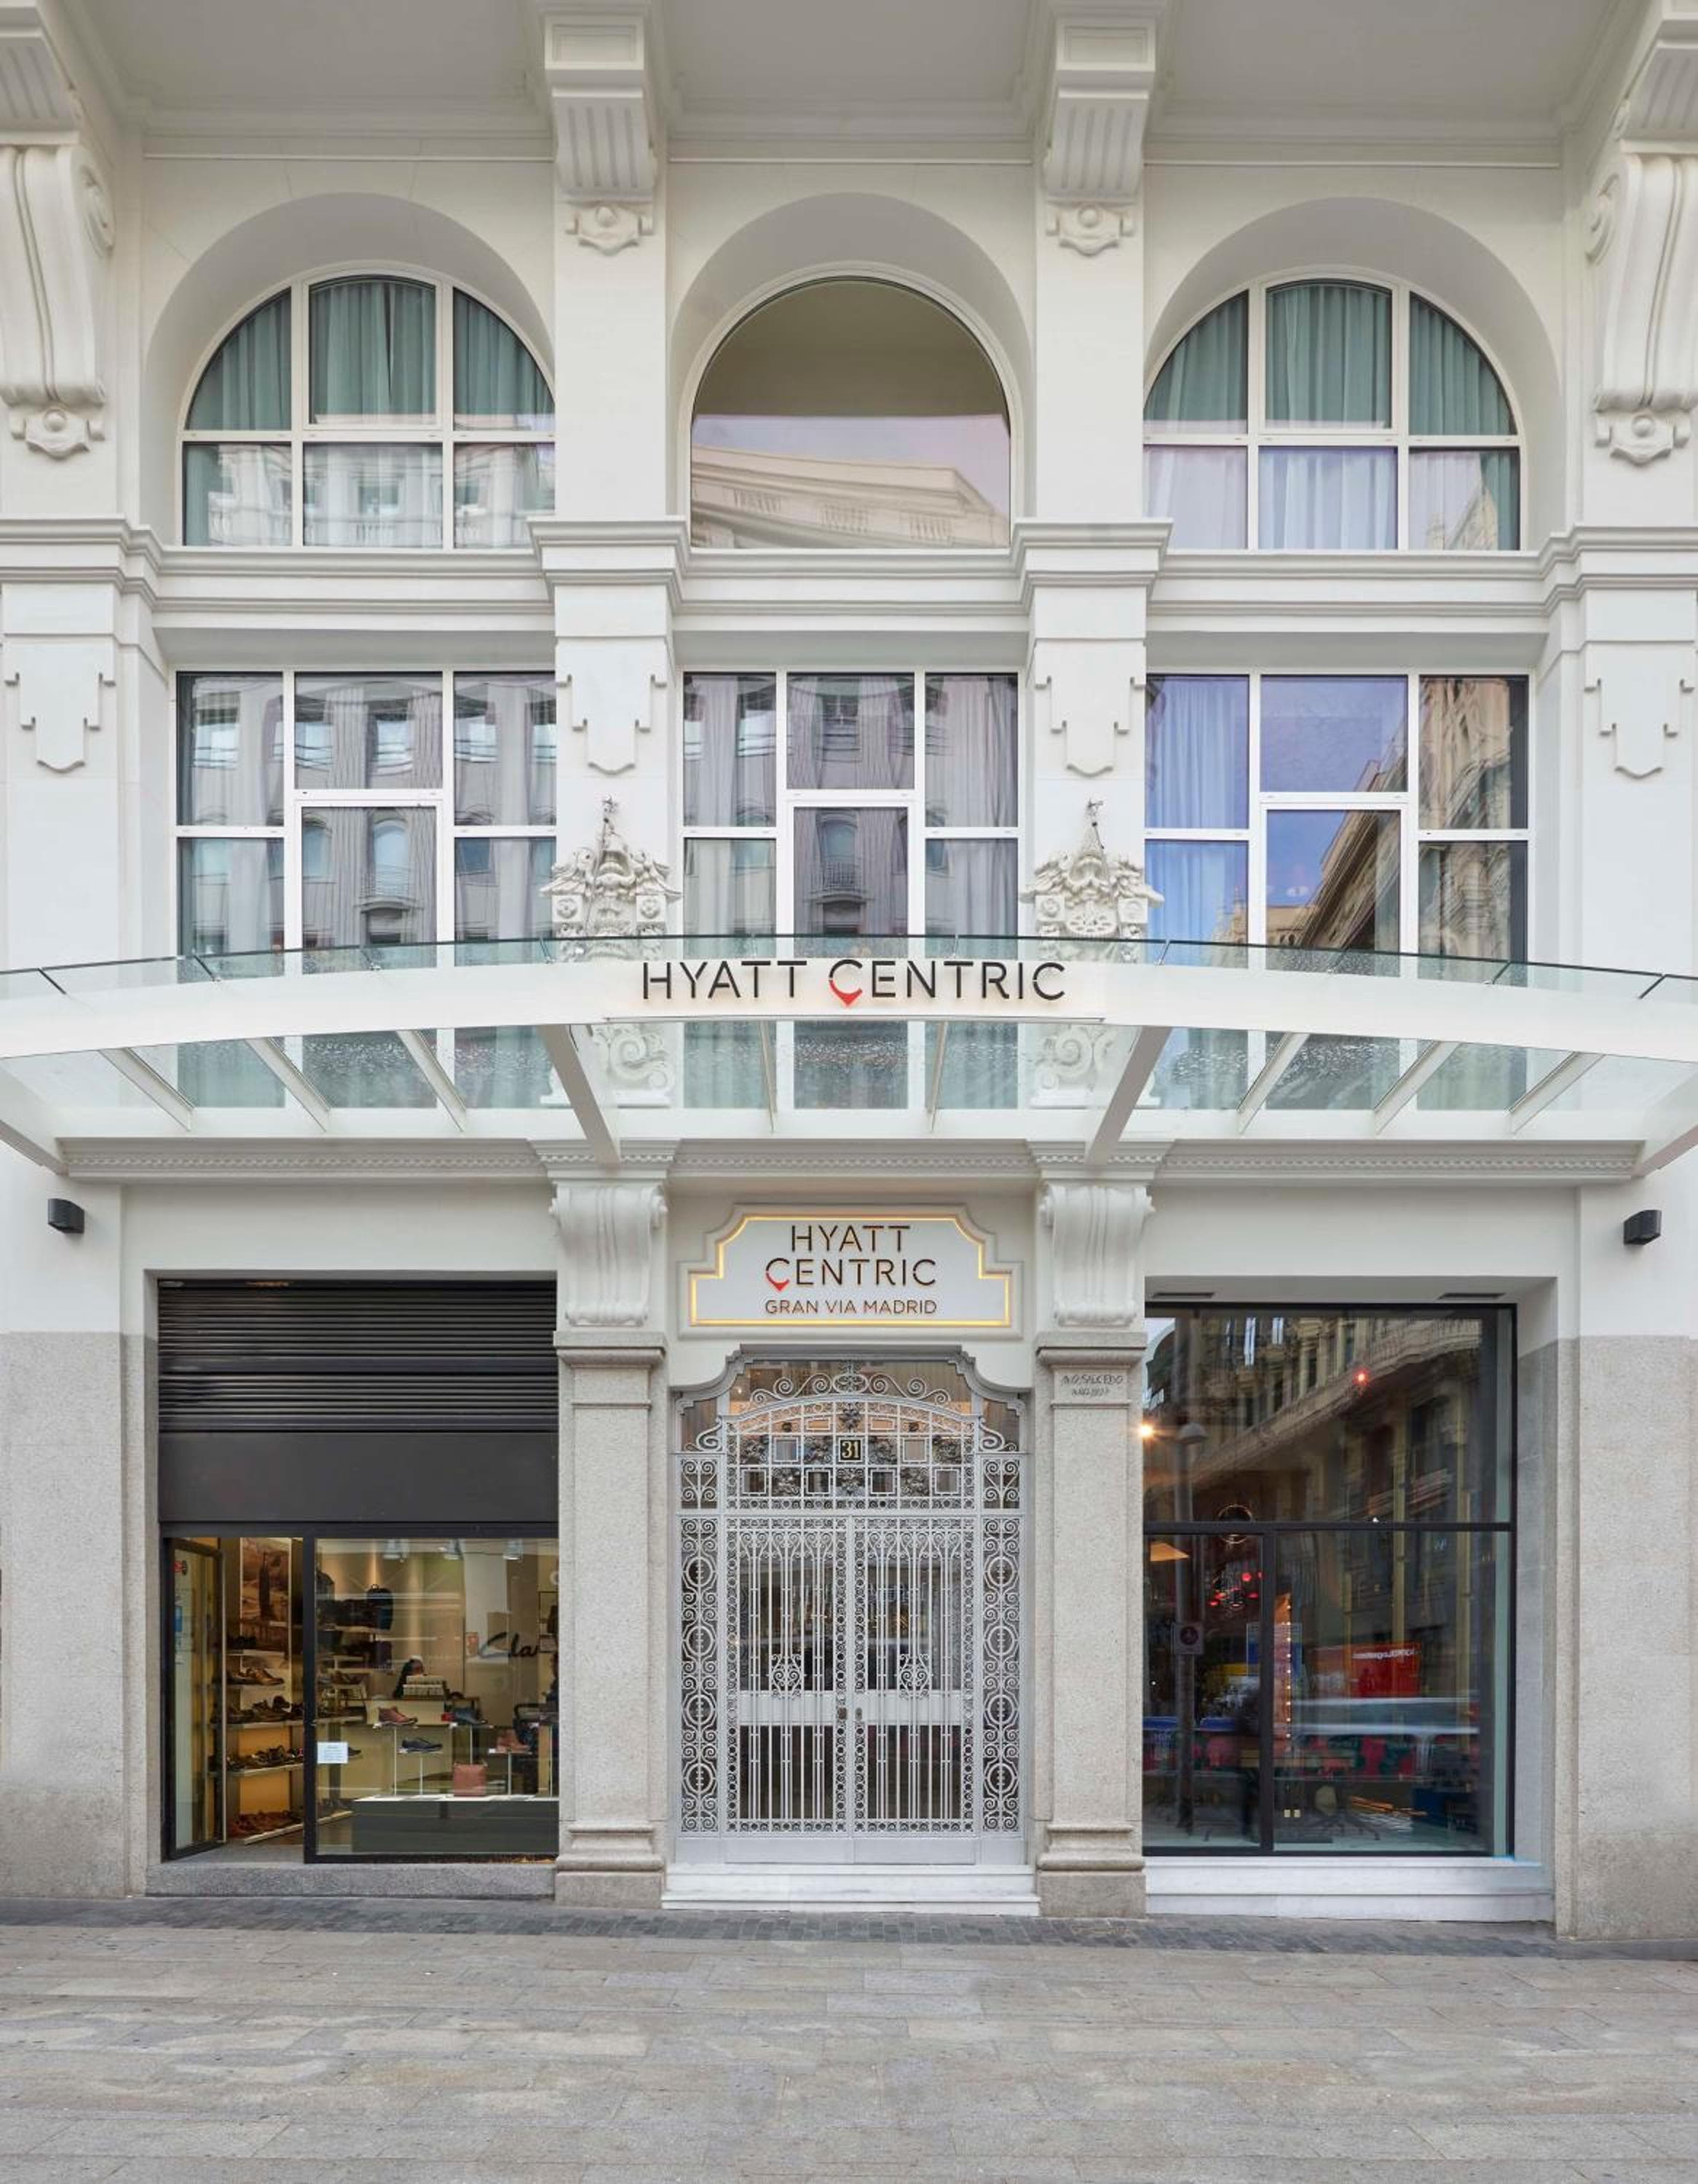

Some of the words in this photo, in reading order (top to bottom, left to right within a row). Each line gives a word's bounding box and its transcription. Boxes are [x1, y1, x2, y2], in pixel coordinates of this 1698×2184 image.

[643, 961, 807, 999] HYATT
[829, 959, 1065, 1006] CENTRIC
[791, 1224, 911, 1252] HYATT
[765, 1258, 936, 1291] CENTRIC
[765, 1299, 819, 1315] GRAN
[825, 1299, 857, 1314] VIA
[863, 1299, 937, 1315] MADRID
[842, 1441, 859, 1458] 31
